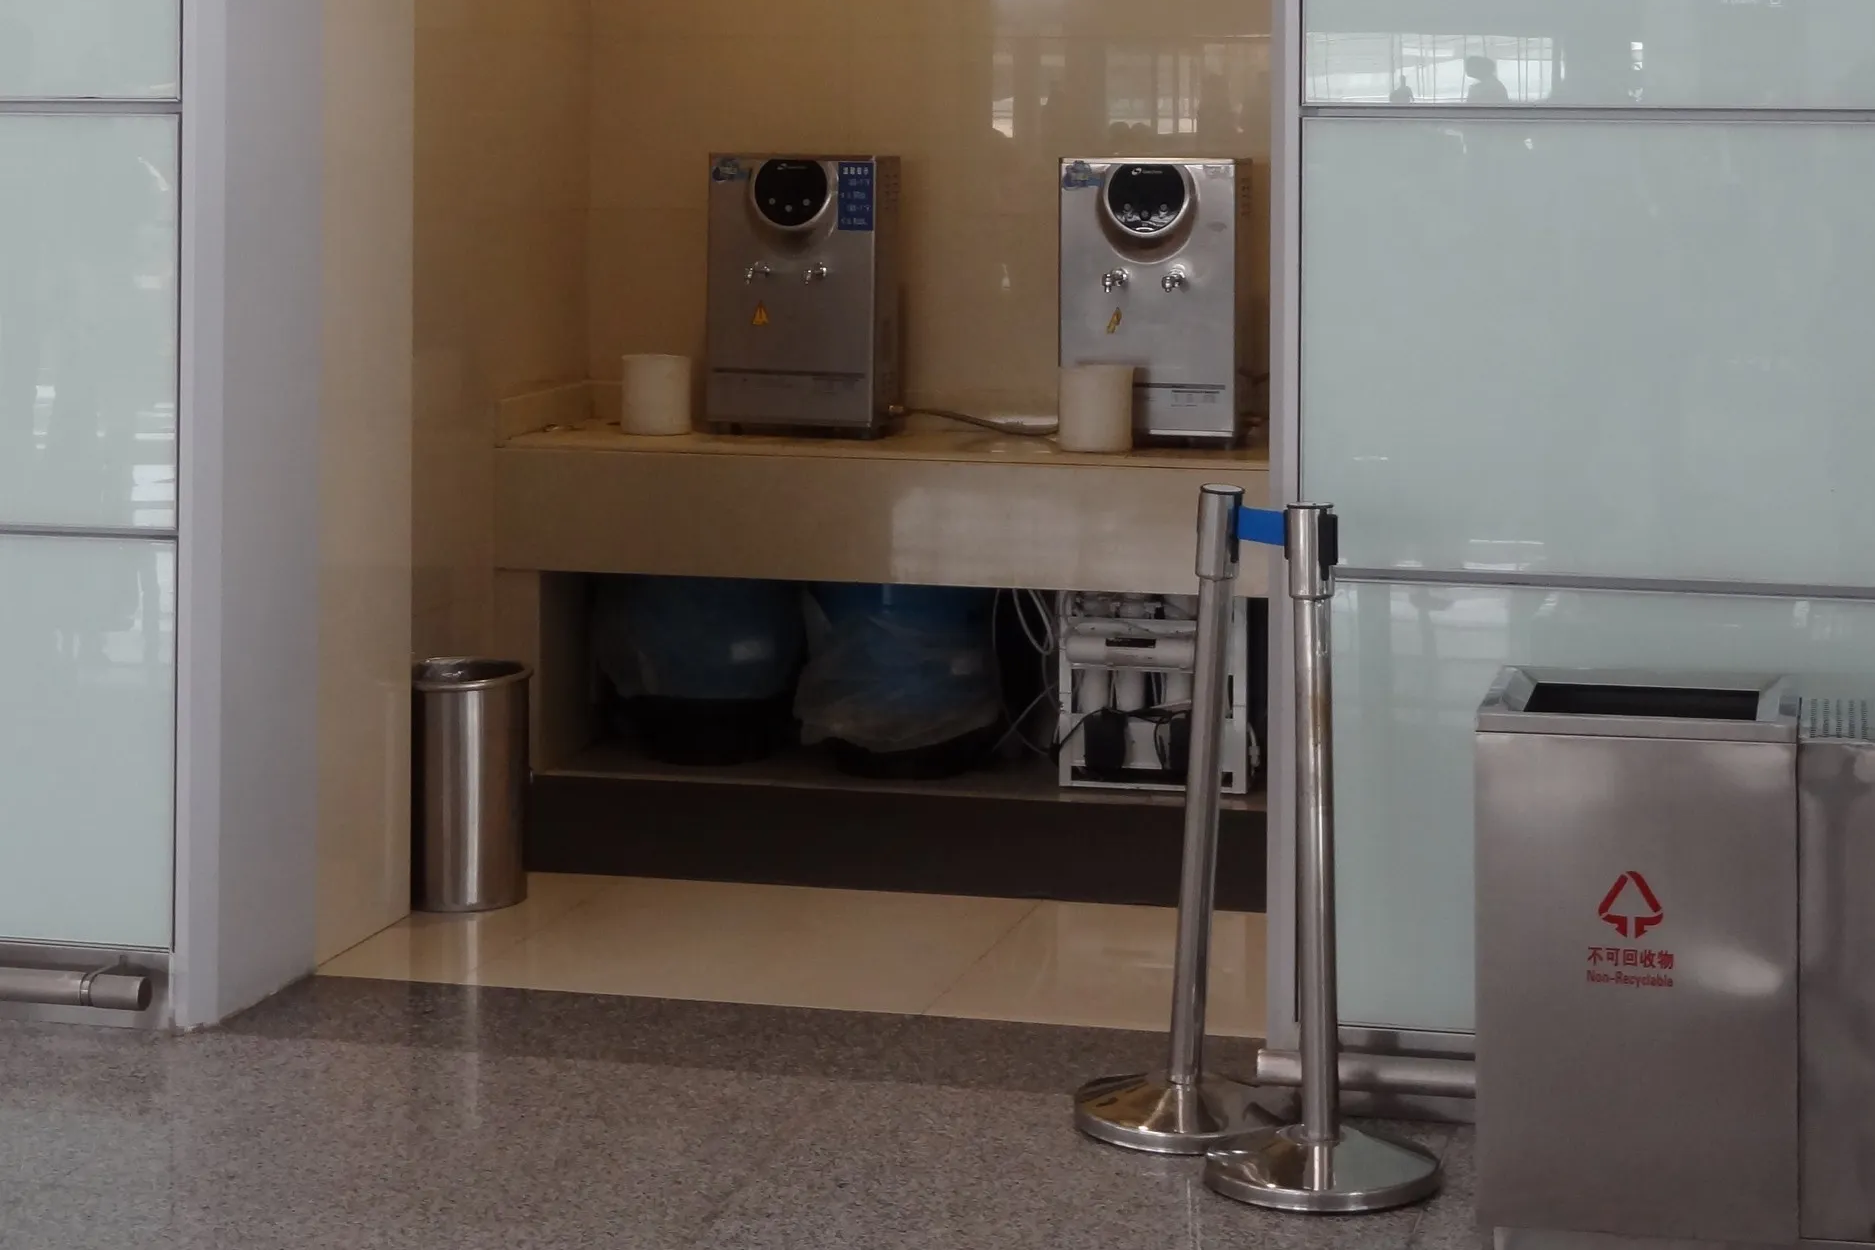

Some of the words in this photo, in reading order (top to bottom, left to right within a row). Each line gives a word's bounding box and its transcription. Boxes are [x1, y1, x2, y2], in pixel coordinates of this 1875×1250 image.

[1587, 946, 1674, 969] 不可回收物
[1586, 970, 1674, 988] Non-Recyclable
